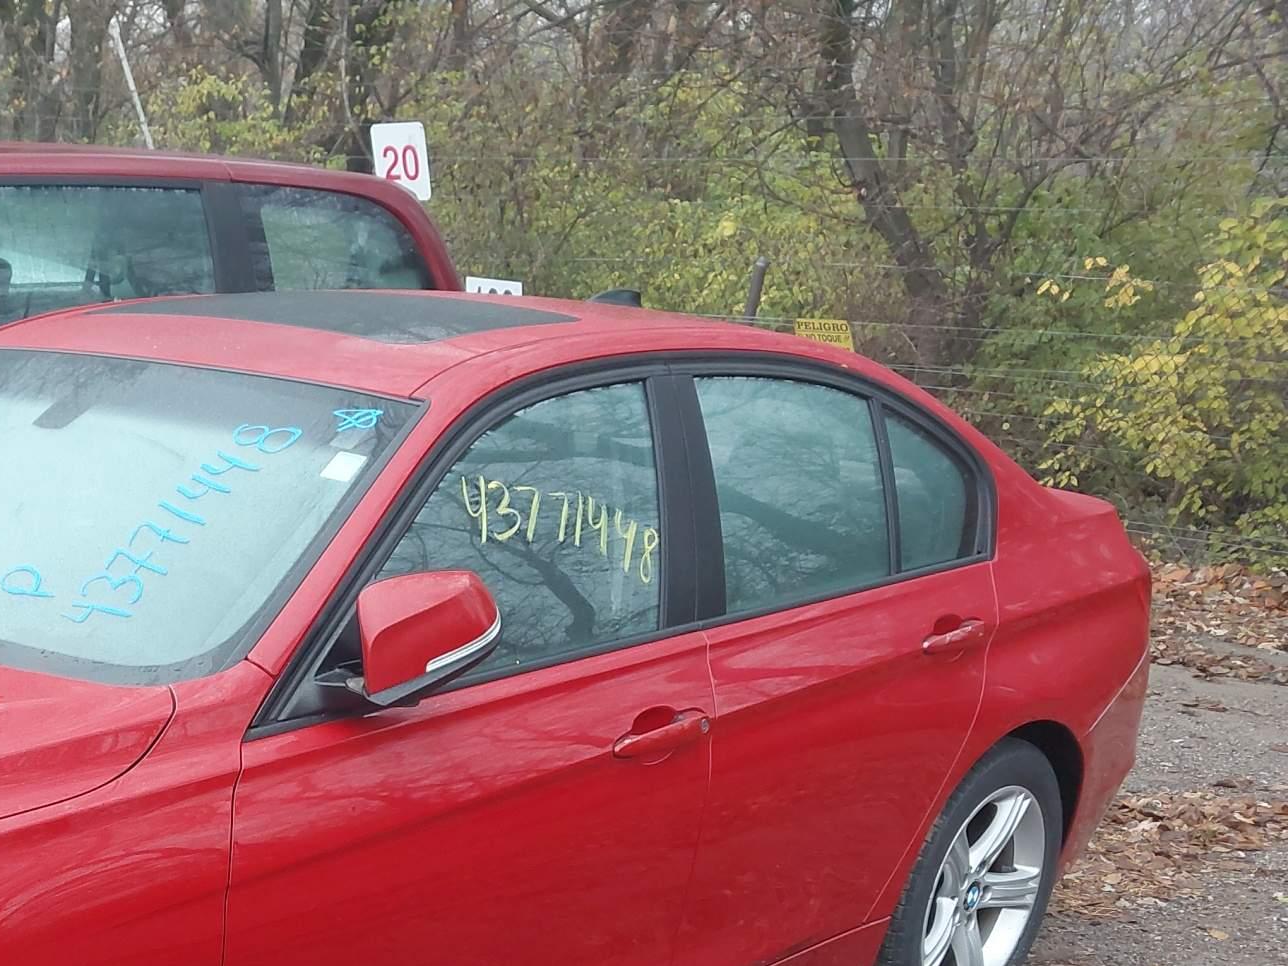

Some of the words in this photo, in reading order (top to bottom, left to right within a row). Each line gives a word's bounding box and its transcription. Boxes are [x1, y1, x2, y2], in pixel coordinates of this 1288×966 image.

[383, 145, 419, 180] 20
[797, 321, 848, 332] PELIGRO
[61, 424, 302, 623] 43771448
[461, 474, 659, 584] 43771448
